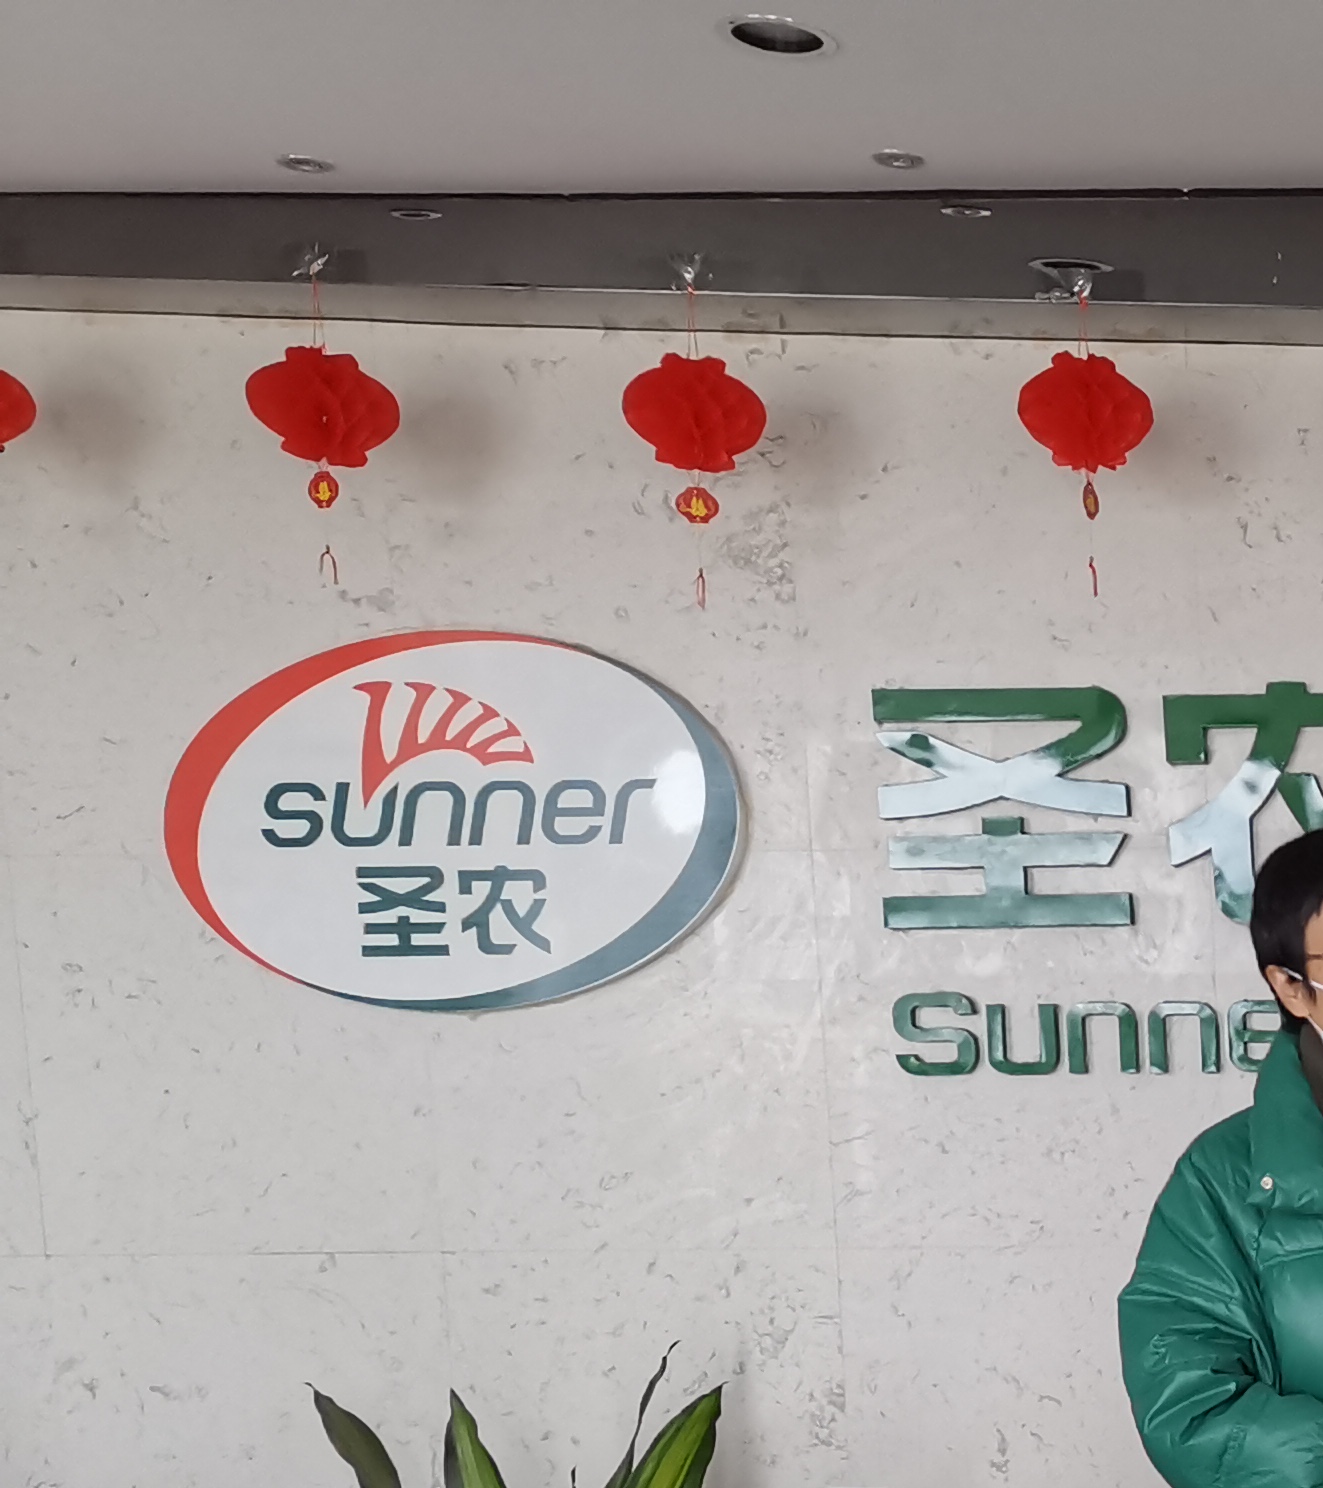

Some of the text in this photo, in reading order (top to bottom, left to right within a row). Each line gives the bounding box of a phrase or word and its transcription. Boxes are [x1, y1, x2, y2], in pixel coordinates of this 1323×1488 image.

[260, 776, 656, 848] sunner
[356, 866, 552, 957] 圣农
[891, 991, 1282, 1077] Sunne
